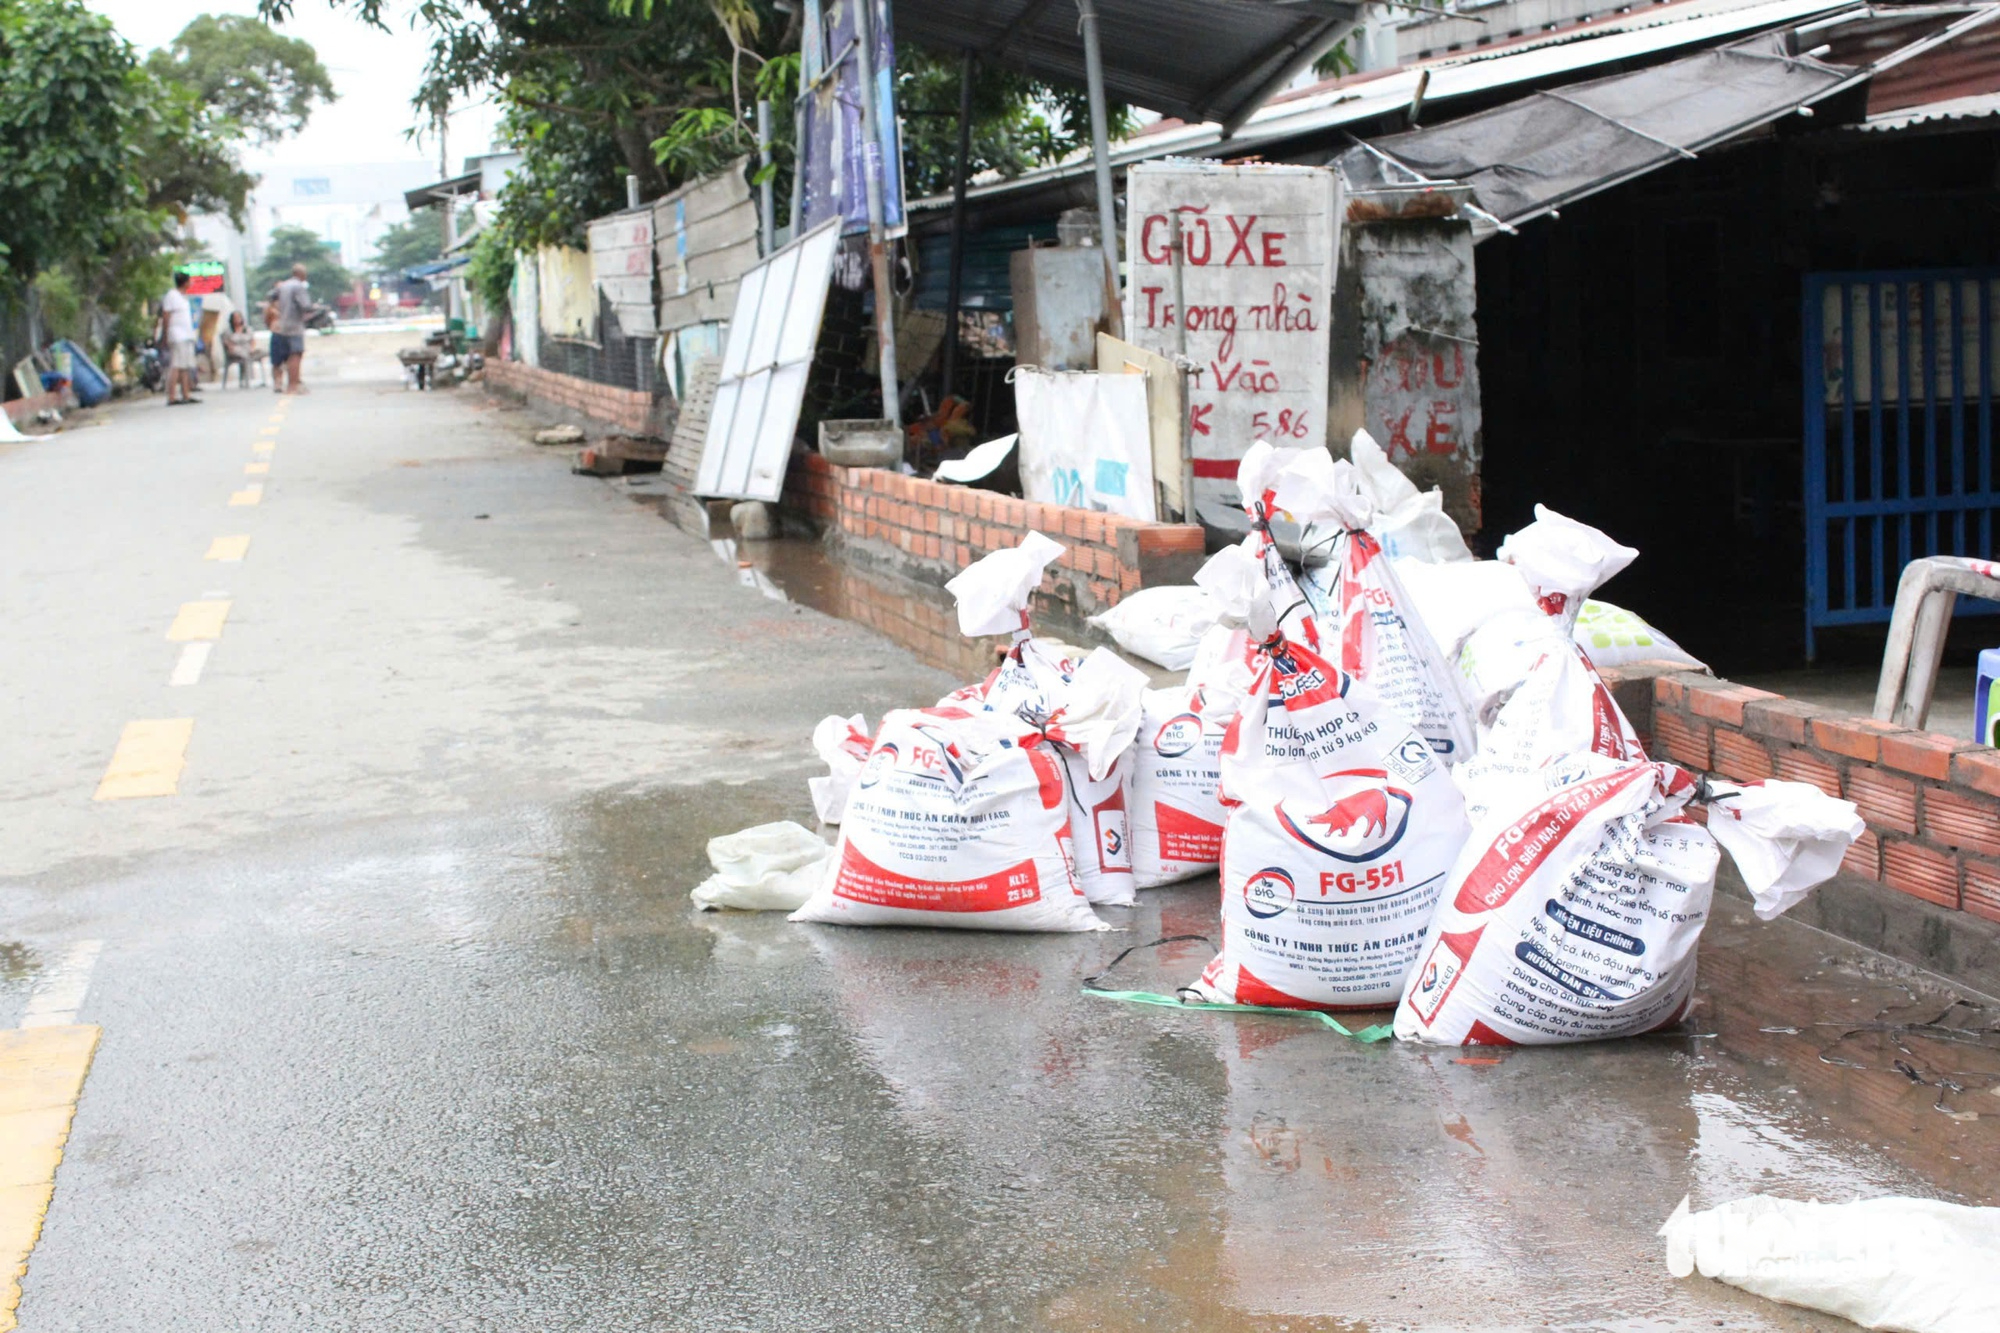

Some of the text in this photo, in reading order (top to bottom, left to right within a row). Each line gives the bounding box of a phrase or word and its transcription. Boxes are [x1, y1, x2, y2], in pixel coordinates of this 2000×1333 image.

[1225, 215, 1287, 268] XE
[1252, 408, 1309, 439] 586
[1265, 744, 1286, 756] Cho
[1288, 745, 1306, 760] lợn
[1335, 737, 1345, 748] 9
[1156, 768, 1182, 778] CÔNG
[1186, 770, 1198, 778] TY
[1485, 883, 1507, 906] CHO
[1502, 862, 1525, 885] LỢN
[1519, 840, 1543, 866] SIÊU
[1538, 820, 1561, 845] NẠC
[1556, 808, 1573, 825] TỪ
[1569, 792, 1591, 813] TẬP
[1008, 874, 1029, 886] KLT:
[1319, 860, 1405, 897] FG-551
[1666, 880, 1689, 894] max
[1007, 890, 1020, 901] 25
[1596, 902, 1622, 920] Hooc
[1244, 928, 1414, 953] CÔNG TY TNHH THỨC ĂN CHĂN
[1581, 922, 1602, 940] LIỆU
[1603, 930, 1635, 951] CHÍNH
[1525, 950, 1560, 978] HƯỚNG
[1560, 969, 1583, 991] DẪN
[1555, 955, 1590, 977] premix
[1599, 972, 1638, 992] vitamin,
[1602, 955, 1624, 972] đậu
[1332, 985, 1352, 993] TCCS
[1425, 964, 1455, 1014] FAGOFEED
[1511, 967, 1538, 986] Dùng
[1539, 980, 1559, 996] cho
[1499, 993, 1526, 1013] Cung
[1527, 1005, 1548, 1021] cấp
[1505, 981, 1537, 1002] Không
[1558, 1006, 1579, 1018] pha
[1493, 1005, 1513, 1020] Bảo
[1514, 1014, 1540, 1031] quản
